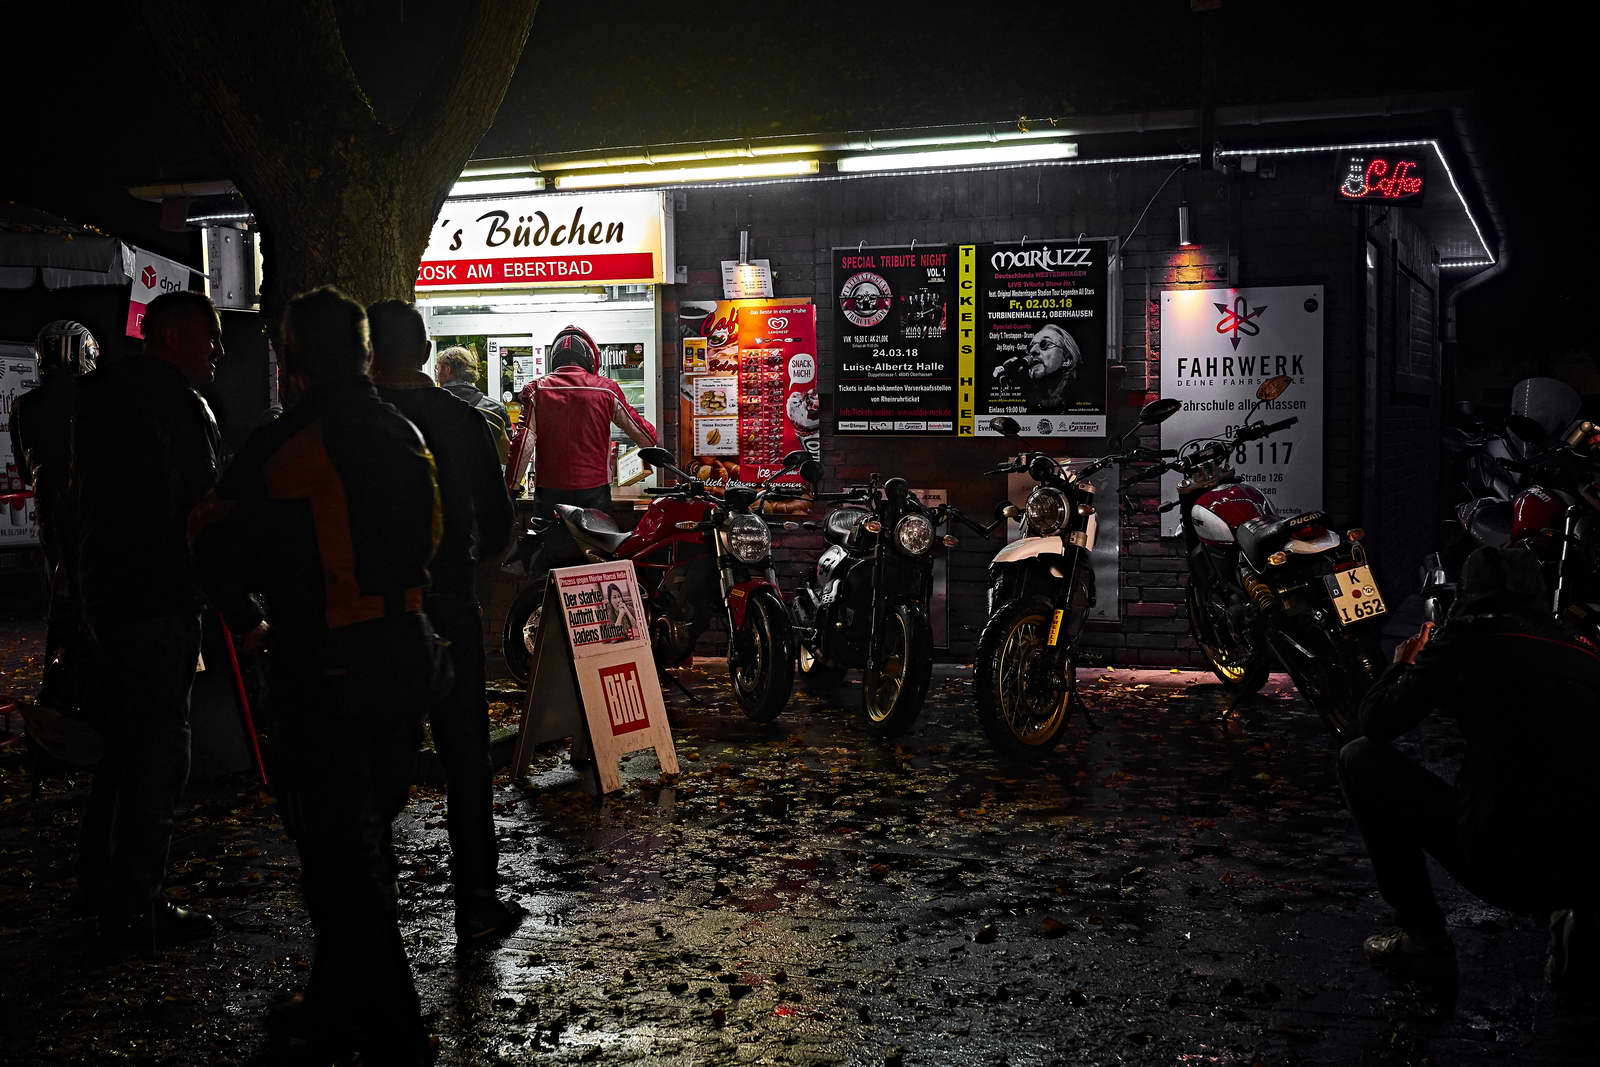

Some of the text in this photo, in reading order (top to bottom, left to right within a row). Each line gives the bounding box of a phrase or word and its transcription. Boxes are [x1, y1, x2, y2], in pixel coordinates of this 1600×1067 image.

[1365, 159, 1422, 198] Coffee
[476, 206, 624, 248] Büdchen
[841, 253, 948, 269] SPECIAL TRIBUTE NIGHT
[417, 261, 593, 280] IOSK AM EBERTBAD
[927, 267, 947, 277] VOL. 1
[160, 277, 181, 292] dpd
[1009, 299, 1072, 310] Fr, 02.03.18
[988, 311, 1040, 319] TURBINENHALLE
[1049, 310, 1093, 318] OBERHAUSEN
[700, 308, 739, 337] Caf
[872, 349, 919, 358] 24.03.18
[792, 359, 812, 368] SNACK
[843, 362, 945, 372] Luise-Albertz Halle
[1178, 355, 1304, 378] FAHRWERK
[793, 369, 811, 378] MICH!
[904, 384, 951, 392] Vorverkaufsstellen
[1178, 377, 1305, 387] DEINE FAHRSE
[1238, 399, 1261, 410] aller
[1266, 398, 1306, 410] Klassen
[757, 466, 770, 479] Ice
[1241, 473, 1283, 482] Straße 126
[1289, 512, 1321, 527] DUCATI
[1347, 570, 1361, 585] K
[563, 589, 603, 606] Der starke
[568, 609, 609, 626] Auftritt von
[1341, 598, 1385, 623] I 652
[572, 624, 625, 644] Jadens Mutter
